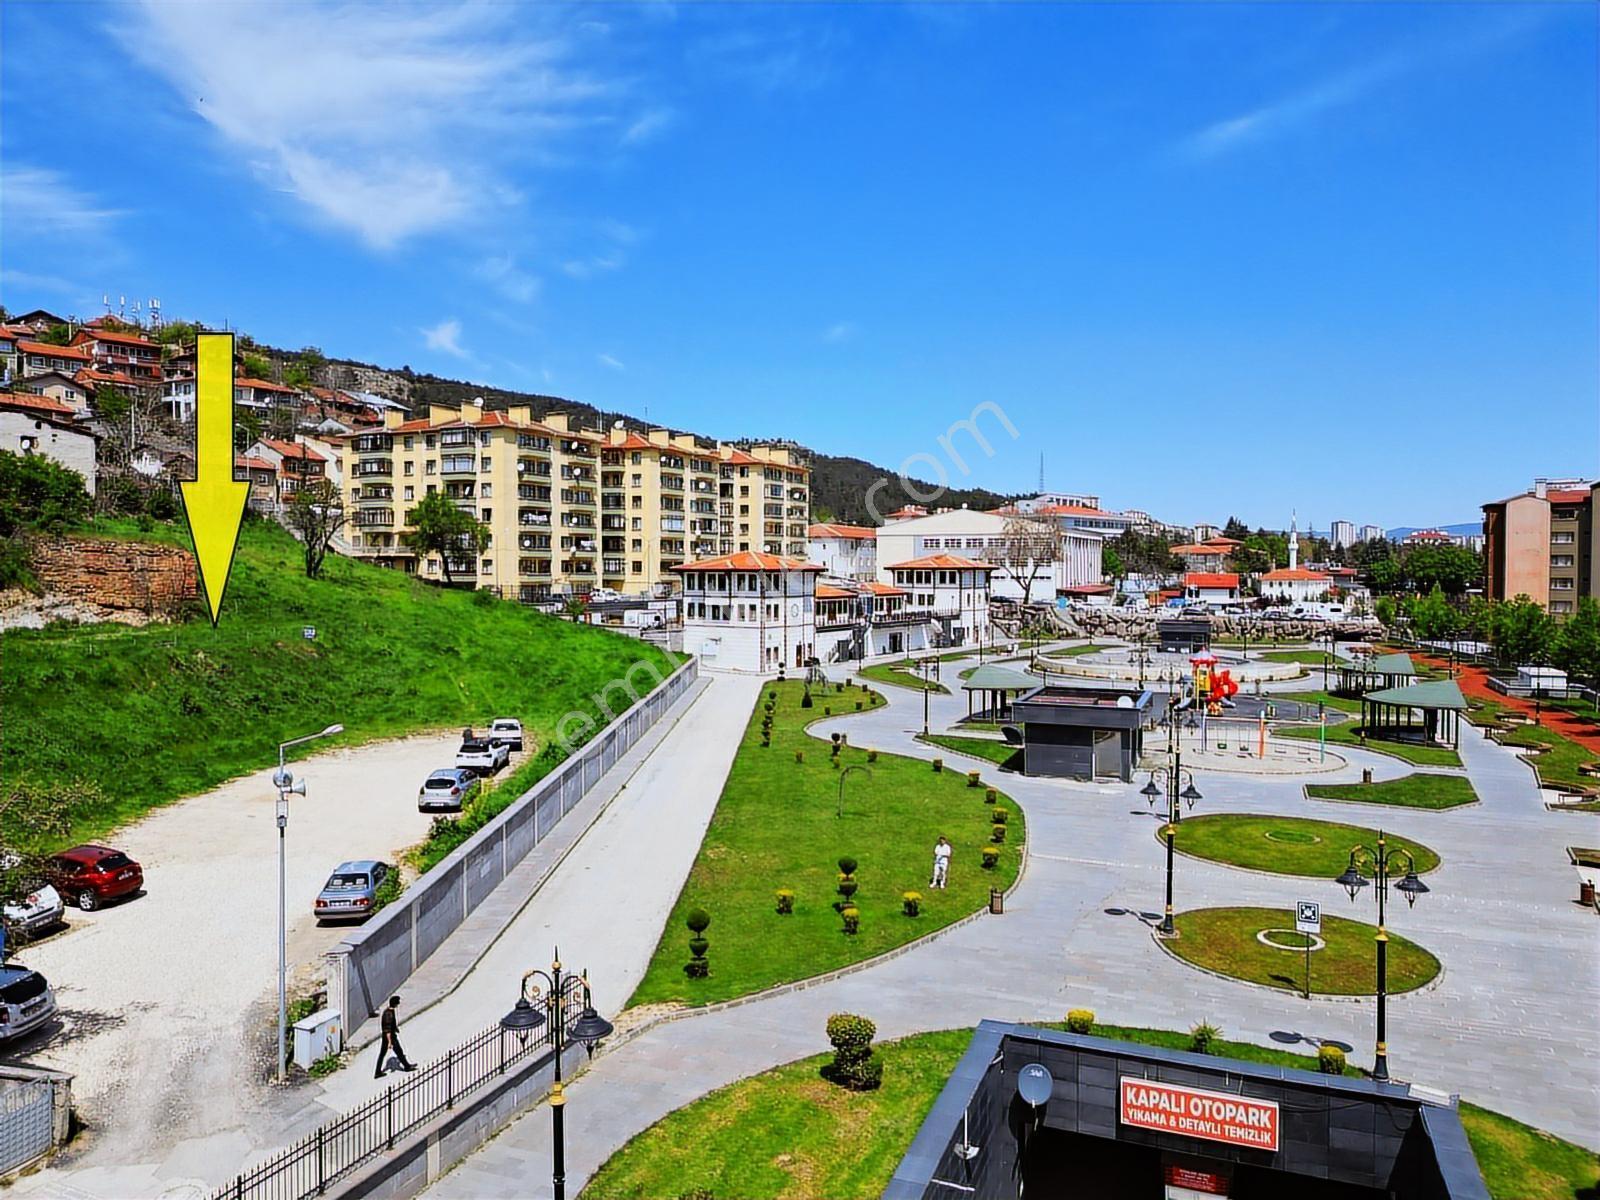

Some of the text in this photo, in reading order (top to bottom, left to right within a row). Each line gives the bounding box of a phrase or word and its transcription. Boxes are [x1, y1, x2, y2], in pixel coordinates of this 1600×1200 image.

[1126, 1086, 1272, 1129] KAPALI OTOPARK
[1127, 1107, 1167, 1126] YIKAMA
[1169, 1117, 1176, 1127] &
[1178, 1116, 1221, 1135] DETAYLI
